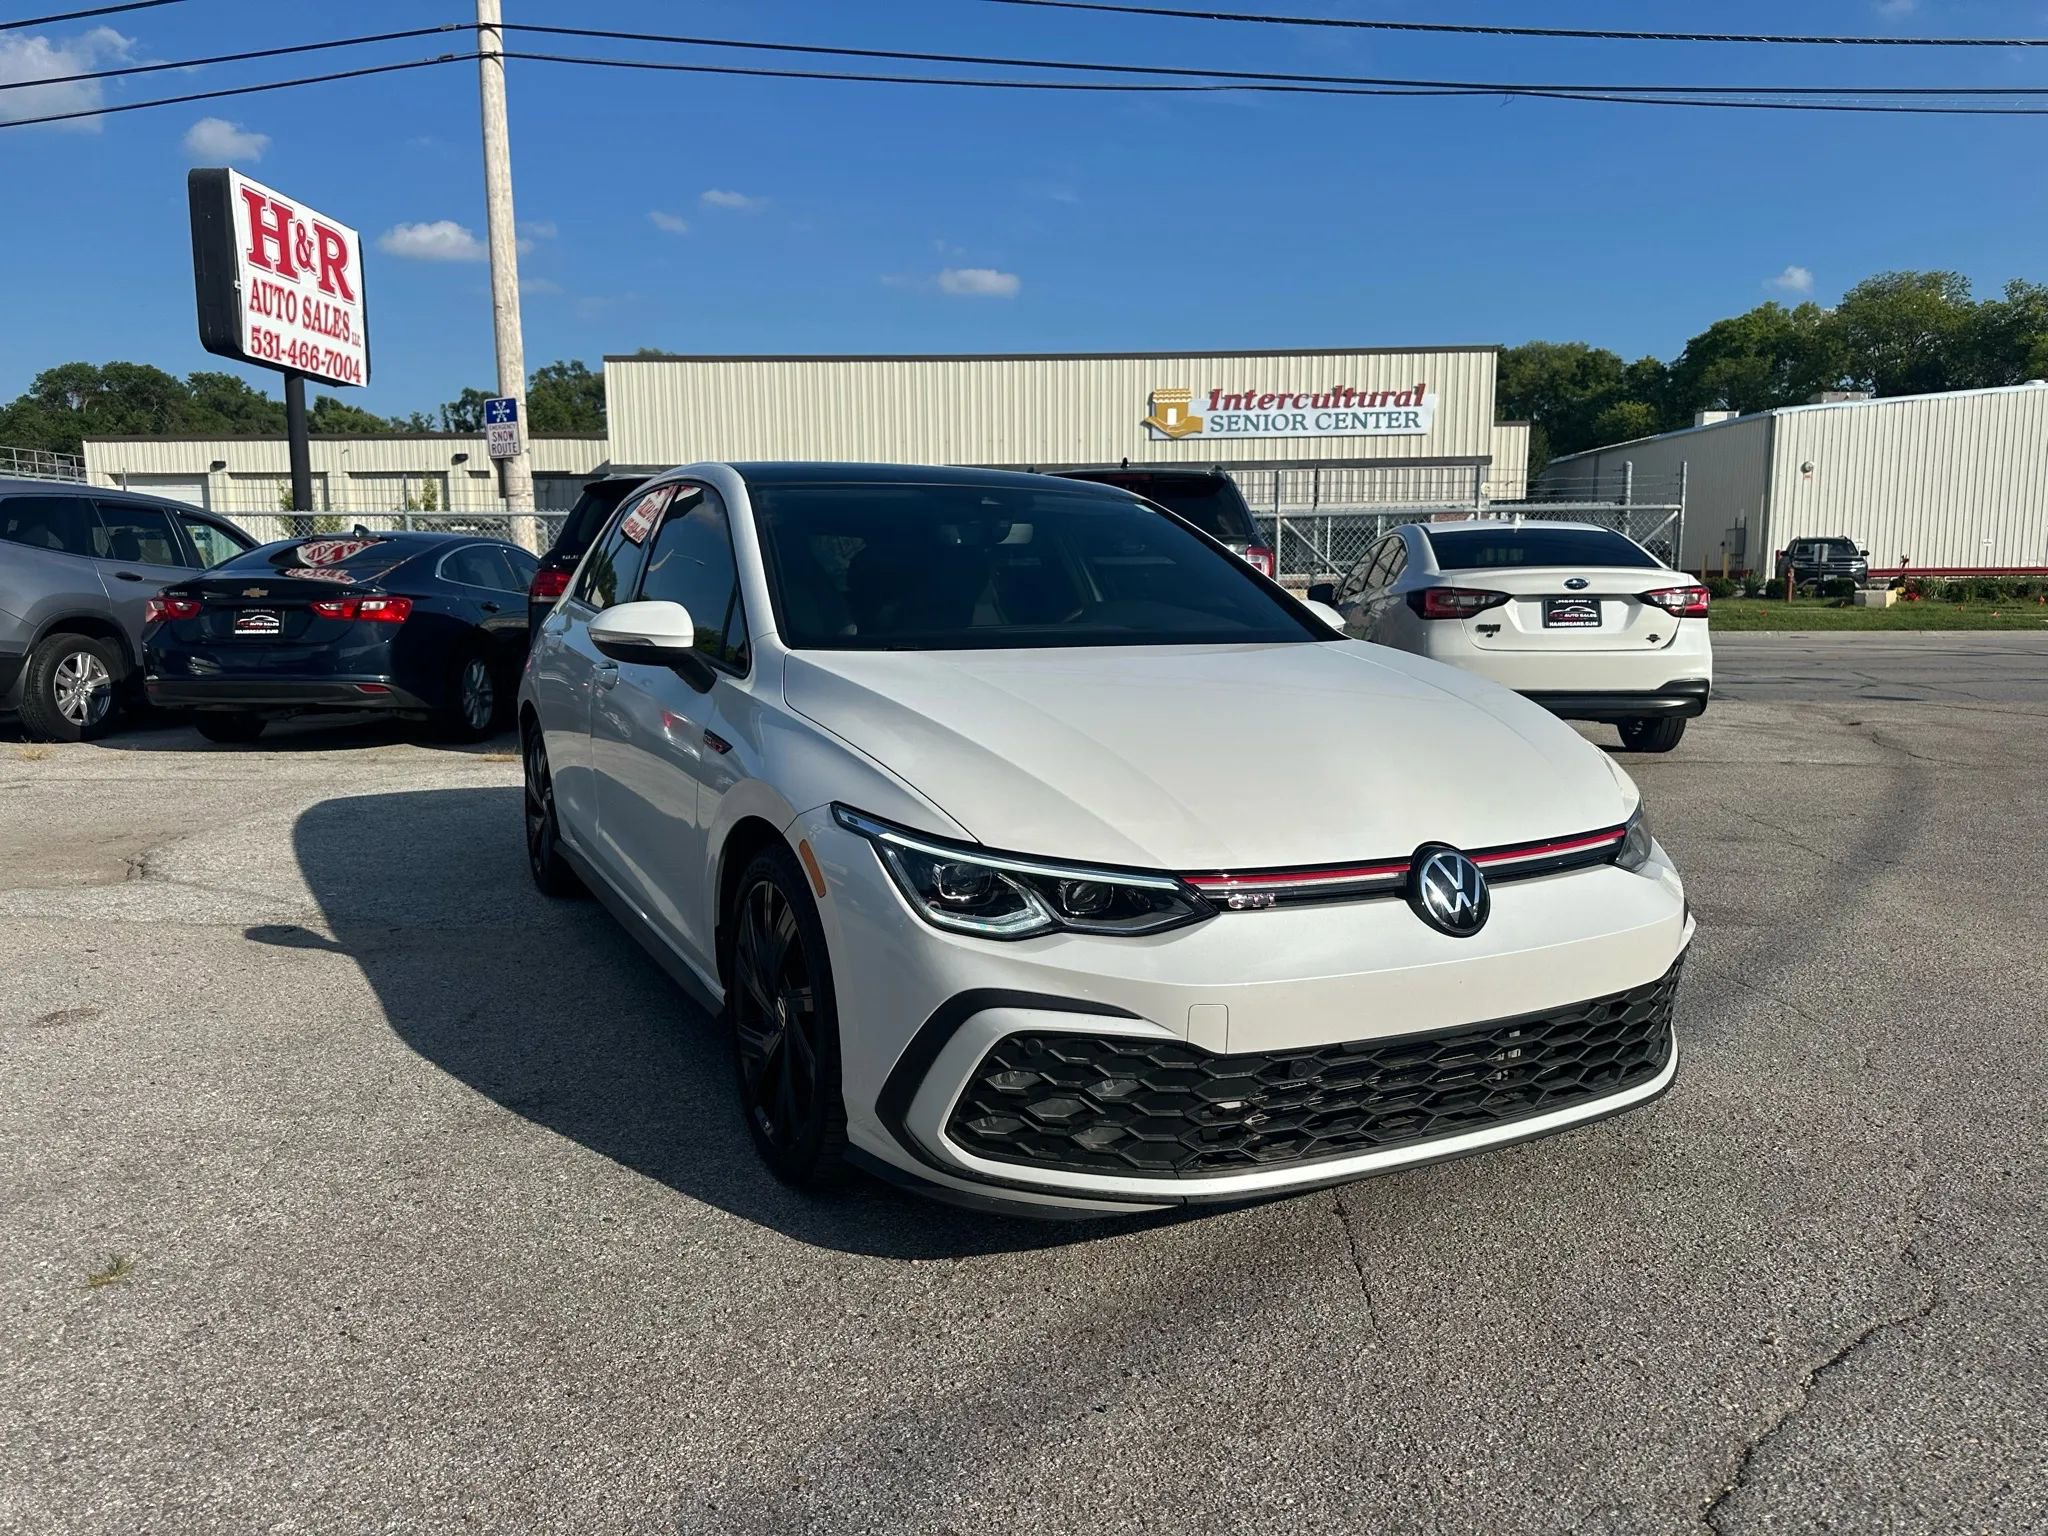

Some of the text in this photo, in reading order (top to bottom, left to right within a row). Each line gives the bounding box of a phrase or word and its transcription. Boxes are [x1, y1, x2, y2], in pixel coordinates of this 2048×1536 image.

[240, 183, 356, 305] H&R
[249, 277, 298, 324] AUTO
[302, 296, 350, 342] SALES
[251, 325, 361, 384] 531-466-7004
[1206, 383, 1426, 411] Intercultural
[1210, 411, 1421, 433] SENIOR CENTER
[491, 442, 518, 454] ROUTE
[492, 431, 514, 442] SNOW
[1228, 893, 1276, 909] GTI
